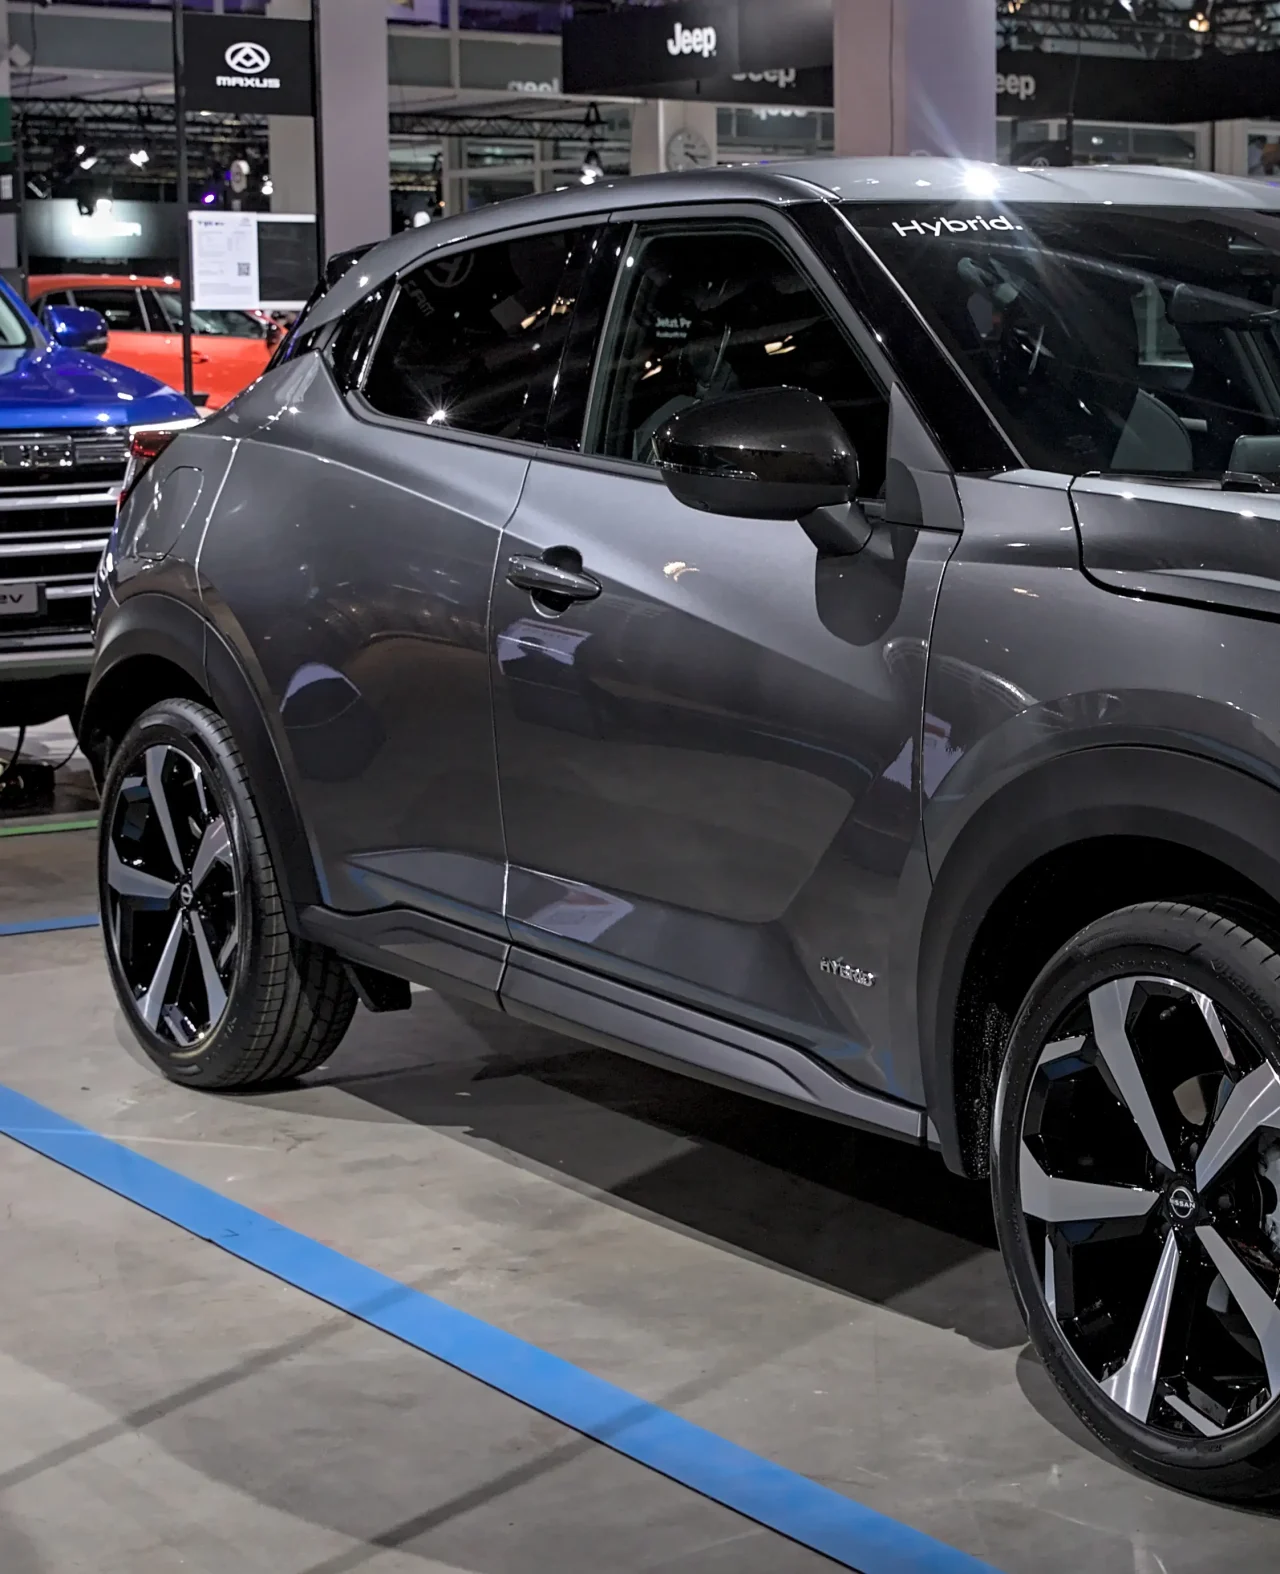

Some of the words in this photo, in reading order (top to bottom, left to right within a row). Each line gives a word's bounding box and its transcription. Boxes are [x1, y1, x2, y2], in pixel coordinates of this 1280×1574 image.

[667, 22, 717, 58] Jeep
[216, 75, 281, 89] MAXUS
[995, 72, 1037, 100] eep
